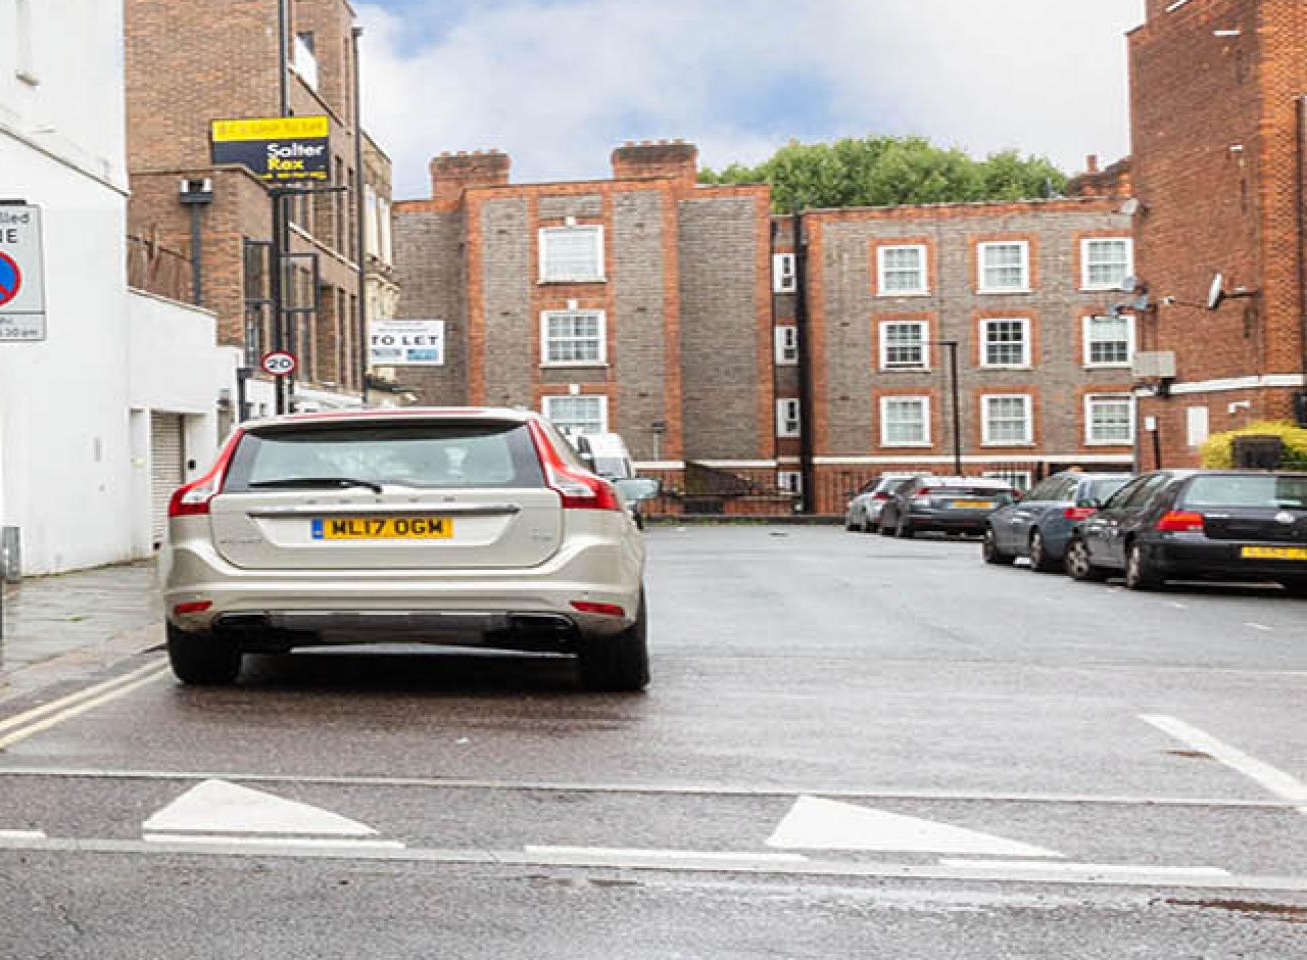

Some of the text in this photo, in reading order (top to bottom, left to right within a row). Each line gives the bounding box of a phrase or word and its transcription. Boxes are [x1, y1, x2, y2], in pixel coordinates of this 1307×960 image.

[266, 142, 324, 156] Salter
[371, 335, 439, 345] TO LET
[266, 358, 292, 369] 20
